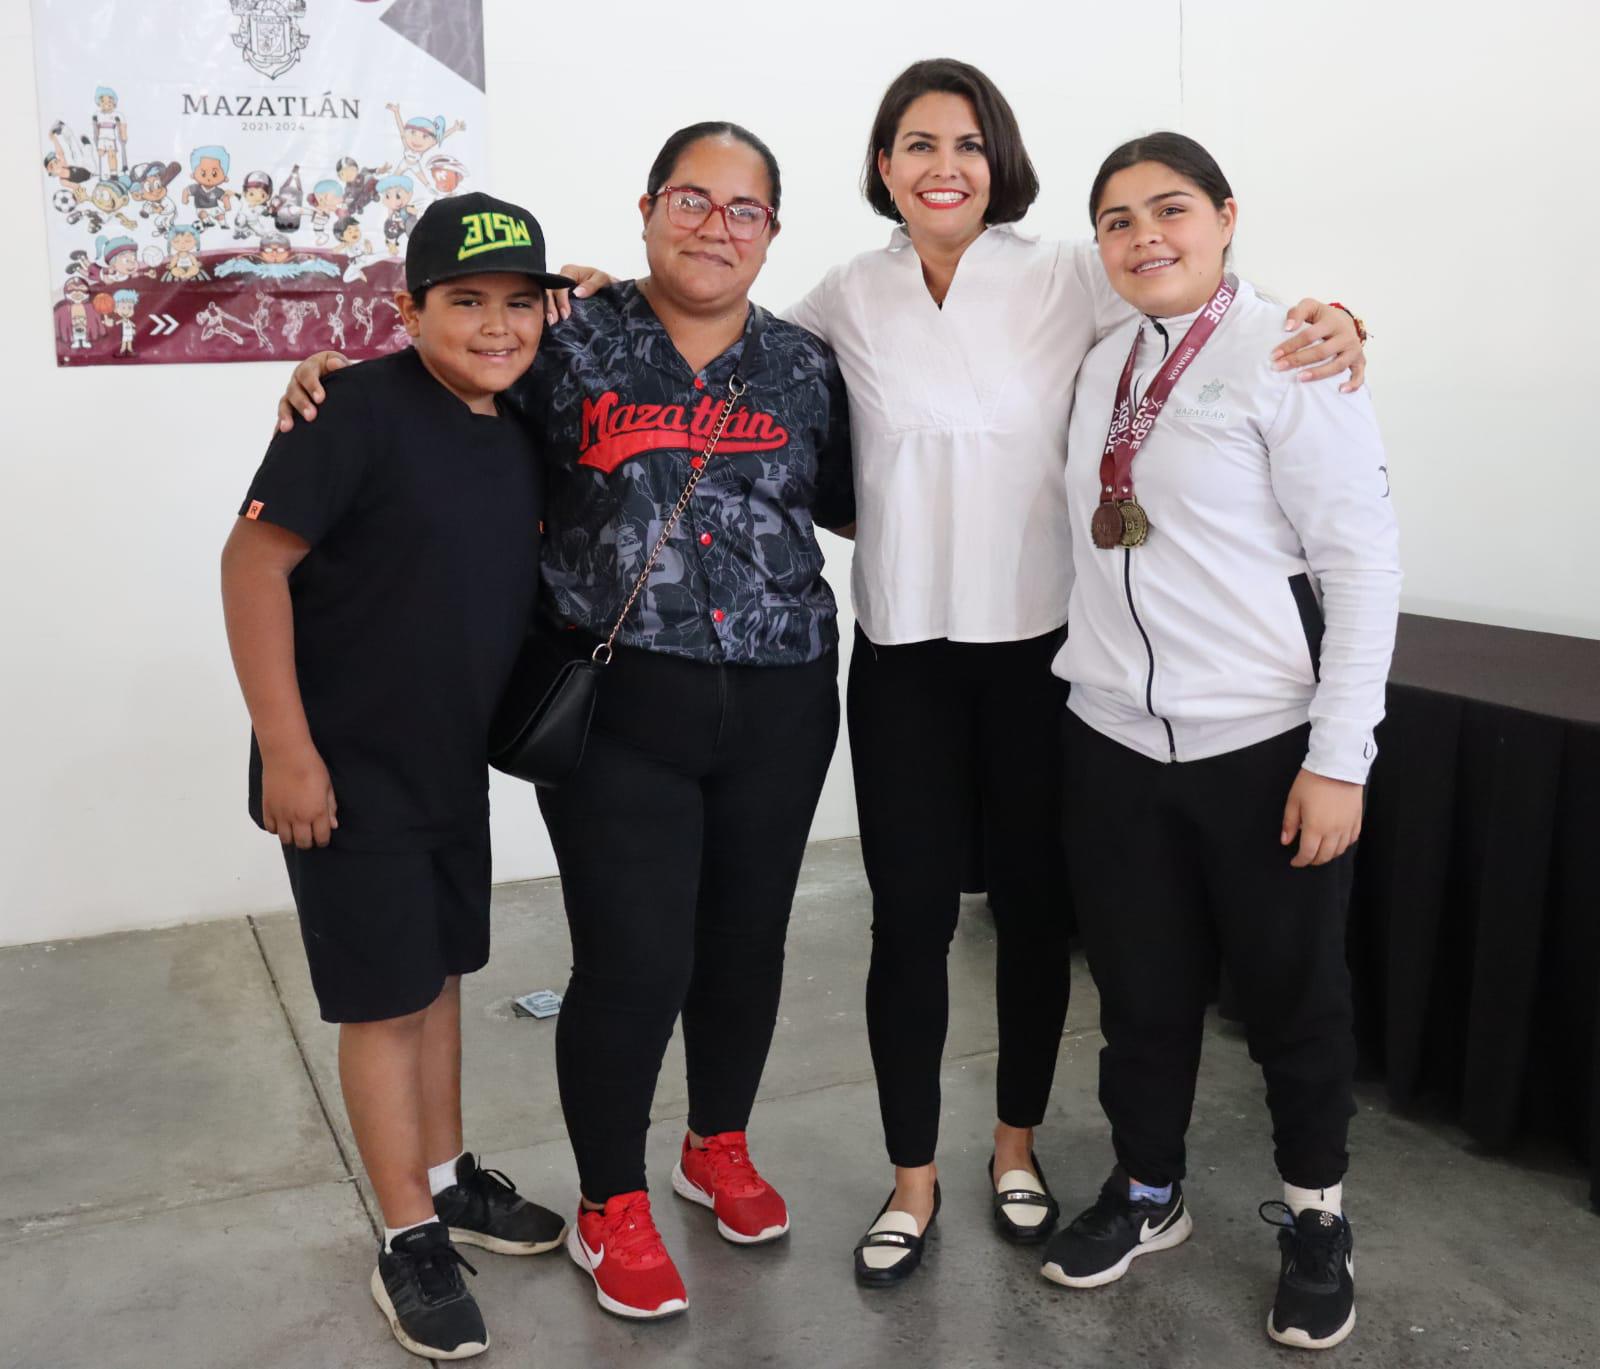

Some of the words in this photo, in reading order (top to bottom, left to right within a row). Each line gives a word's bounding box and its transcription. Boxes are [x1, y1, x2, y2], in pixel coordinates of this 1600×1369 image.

[182, 91, 361, 119] MAZATLÁN
[1204, 287, 1233, 324] ISDE
[1168, 346, 1195, 381] SINALOA
